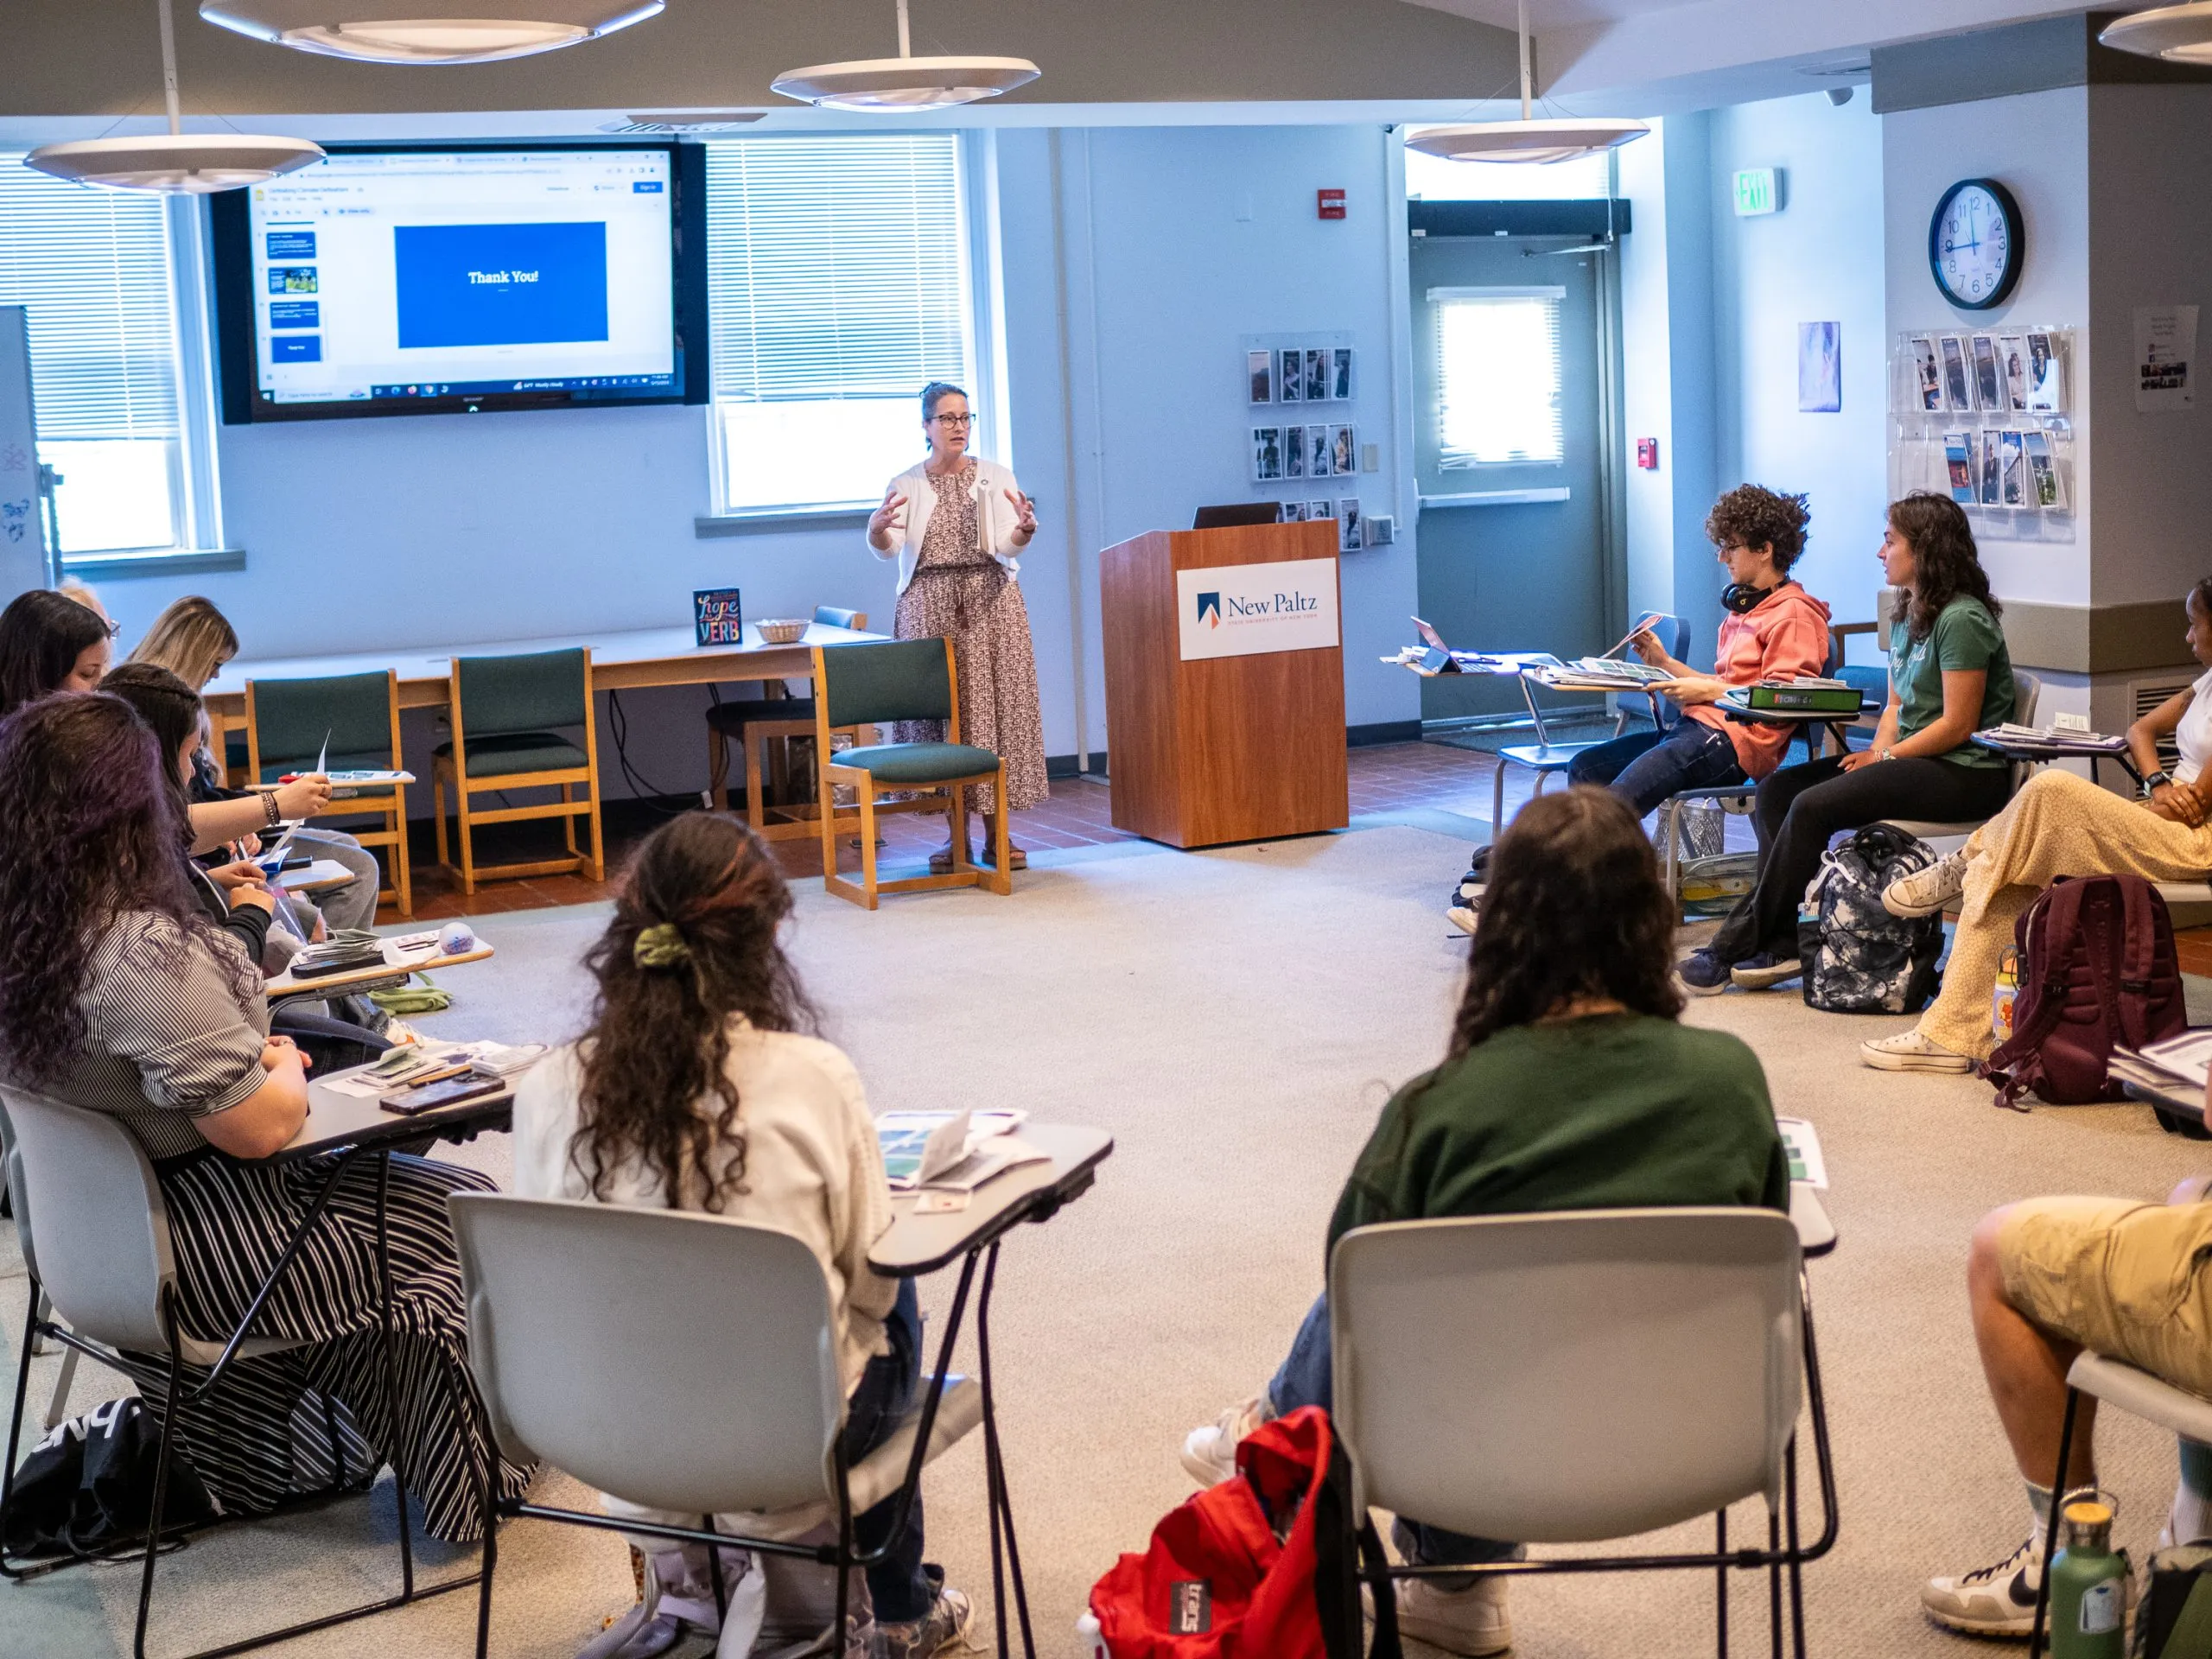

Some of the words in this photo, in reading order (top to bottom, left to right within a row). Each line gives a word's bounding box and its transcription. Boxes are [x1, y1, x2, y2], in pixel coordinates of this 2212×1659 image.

[1959, 203, 1967, 218] 11
[1986, 202, 1991, 215] 1
[1948, 219, 1960, 234] 10
[1994, 217, 2003, 232] 2
[1945, 239, 1954, 253] 9
[1998, 236, 2006, 251] 3
[1948, 259, 1957, 274] 8
[1994, 257, 2003, 270] 4
[467, 270, 511, 284] Thank
[512, 270, 539, 283] You!
[1959, 274, 1966, 289] 7
[1986, 273, 1994, 288] 5
[1972, 279, 1980, 294] 6
[697, 594, 739, 621] hope
[1228, 596, 1270, 617] New
[1274, 590, 1318, 613] Paltz
[699, 620, 740, 642] VERB
